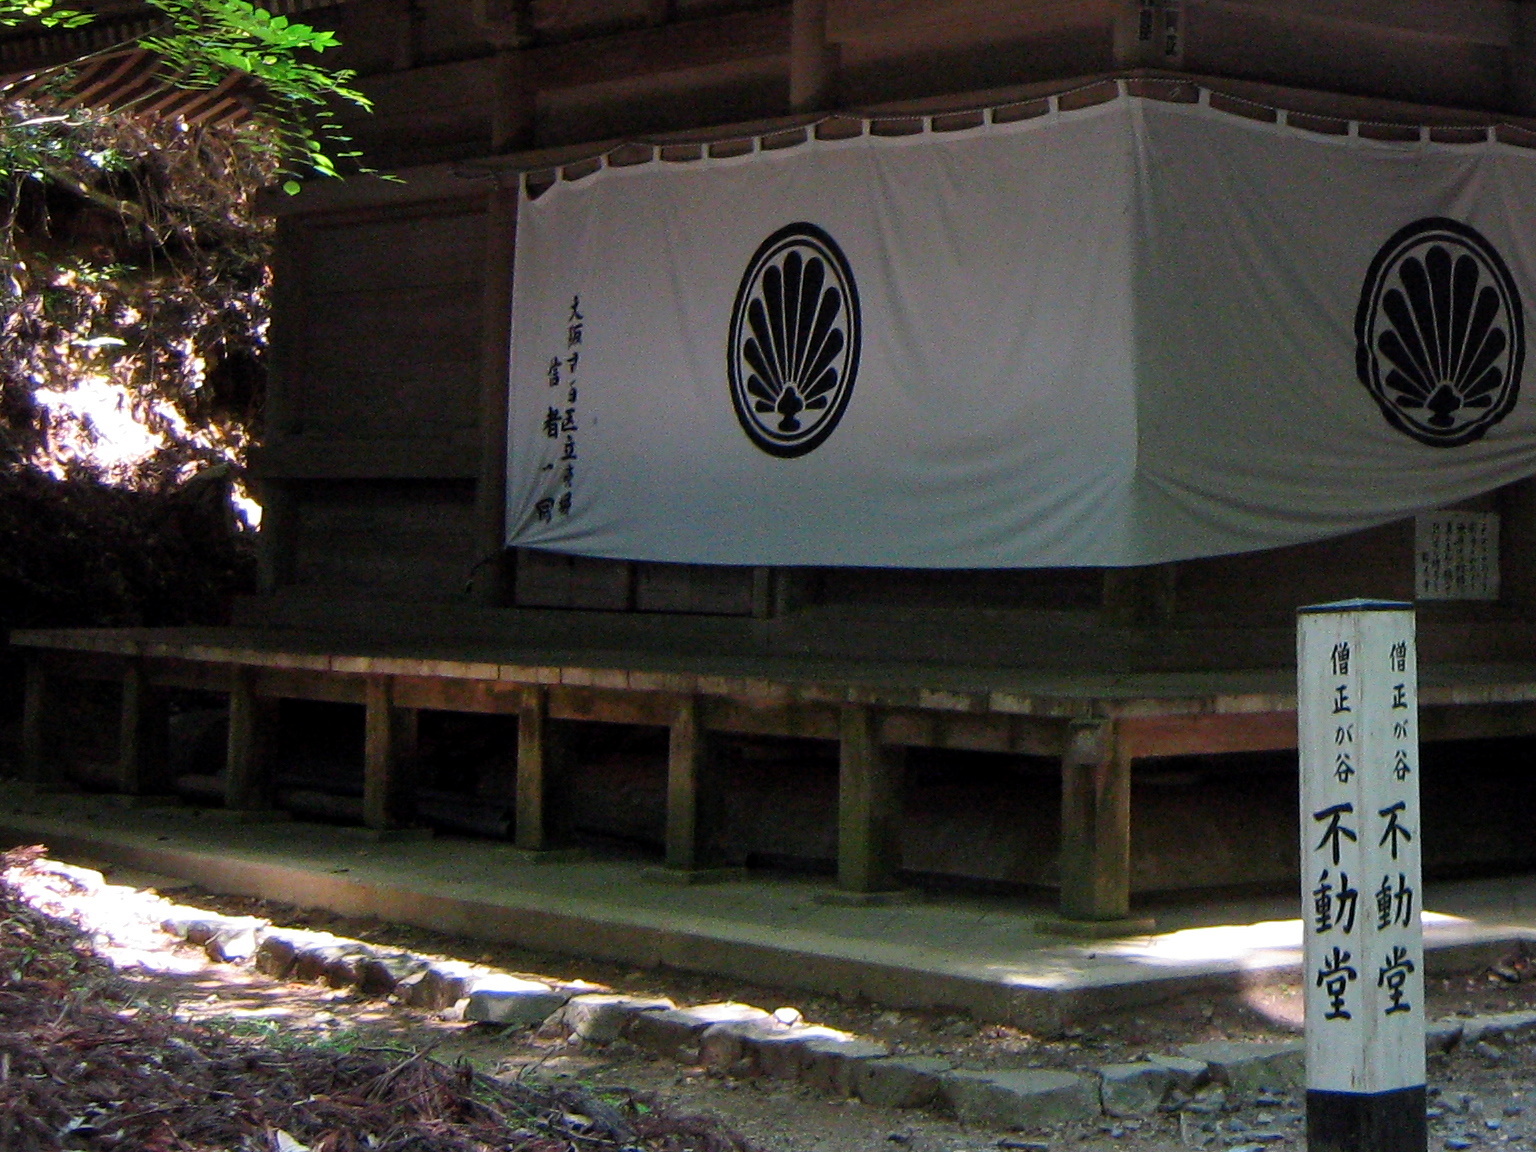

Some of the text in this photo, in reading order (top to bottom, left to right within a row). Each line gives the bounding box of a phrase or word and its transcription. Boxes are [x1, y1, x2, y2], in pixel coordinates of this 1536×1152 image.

[535, 356, 562, 523] 信者一同
[1312, 642, 1359, 1021] 僧正が谷 不動堂
[1375, 641, 1415, 1017] 僧正が谷 不動堂
